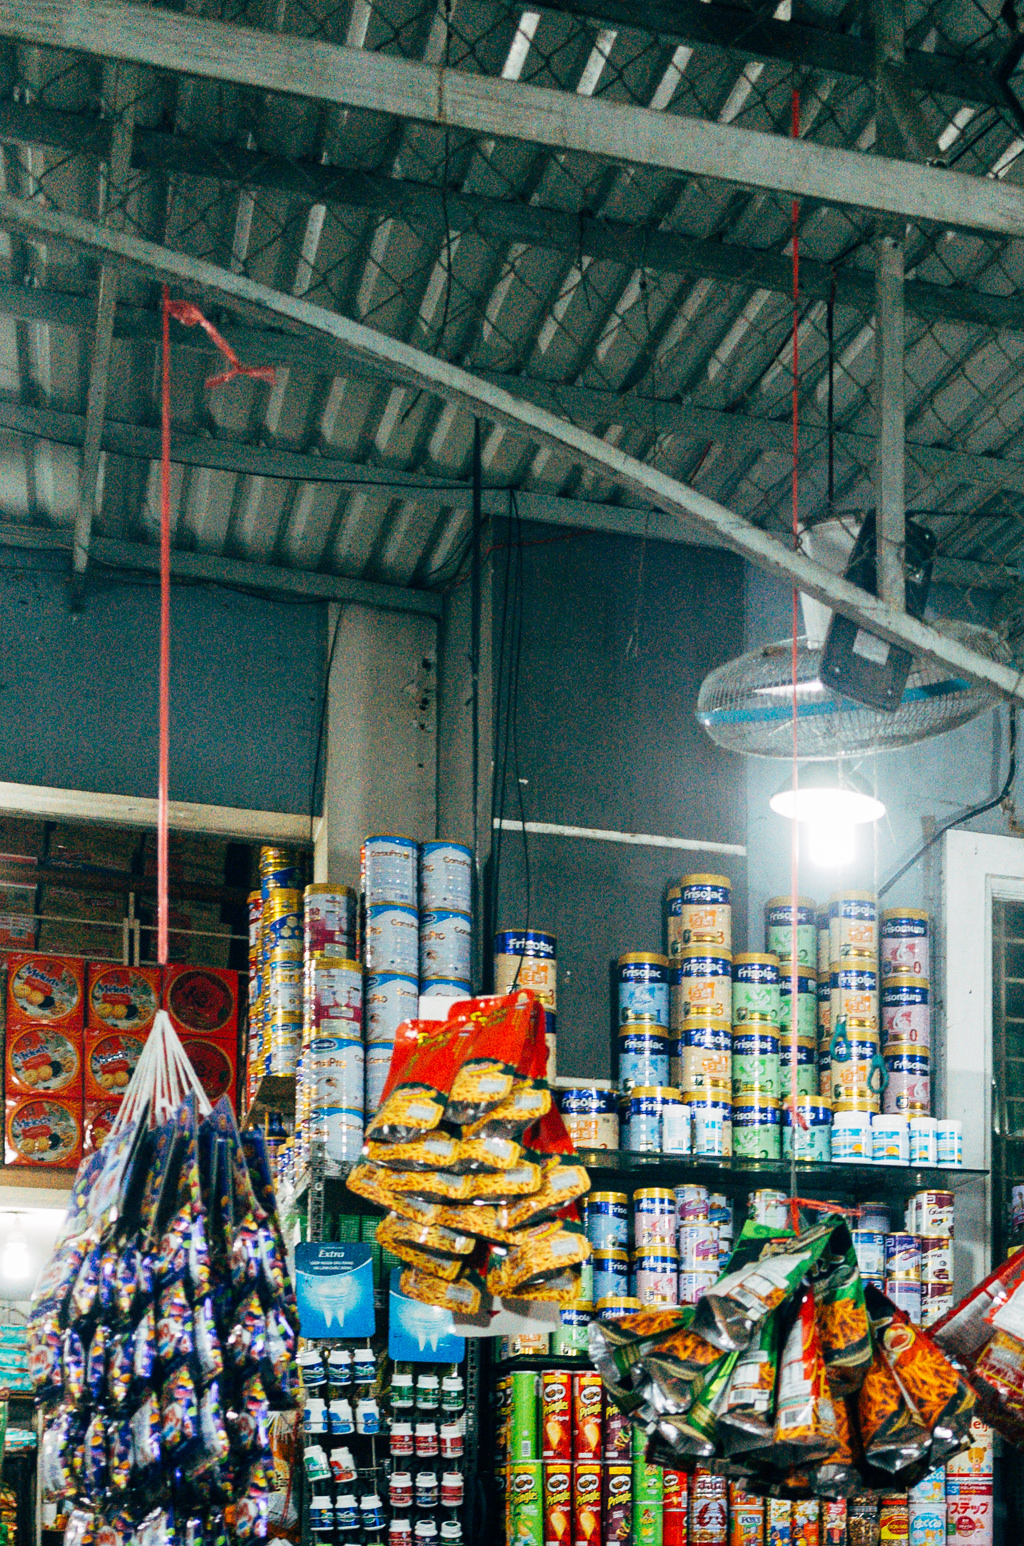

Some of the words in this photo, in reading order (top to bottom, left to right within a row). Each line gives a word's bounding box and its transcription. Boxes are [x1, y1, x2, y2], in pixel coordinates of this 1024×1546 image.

[683, 886, 724, 903] Frisolac
[508, 937, 554, 954] Frisolac
[683, 960, 723, 973] Frisolac
[622, 968, 662, 979] Frisolac
[624, 1039, 665, 1050] Frisolac
[318, 1249, 345, 1258] Extra
